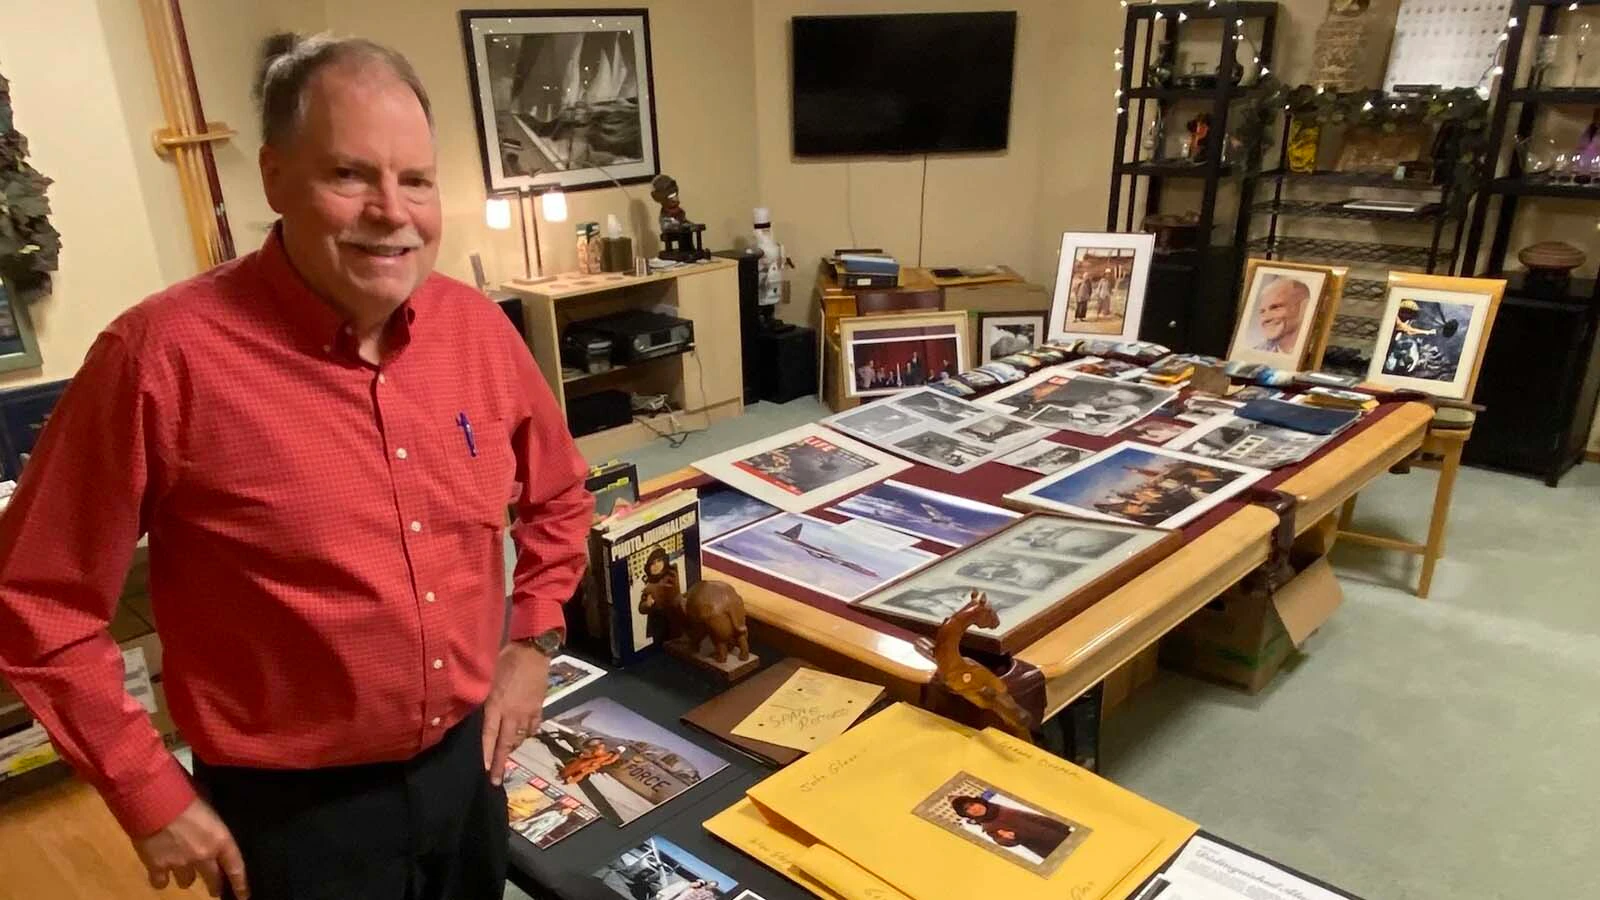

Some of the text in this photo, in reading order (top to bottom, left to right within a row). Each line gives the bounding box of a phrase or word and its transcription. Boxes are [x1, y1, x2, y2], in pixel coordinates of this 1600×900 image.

[804, 436, 838, 452] LIFE
[611, 510, 697, 562] PHOTOJOURNALISM
[628, 763, 672, 793] FORCE
